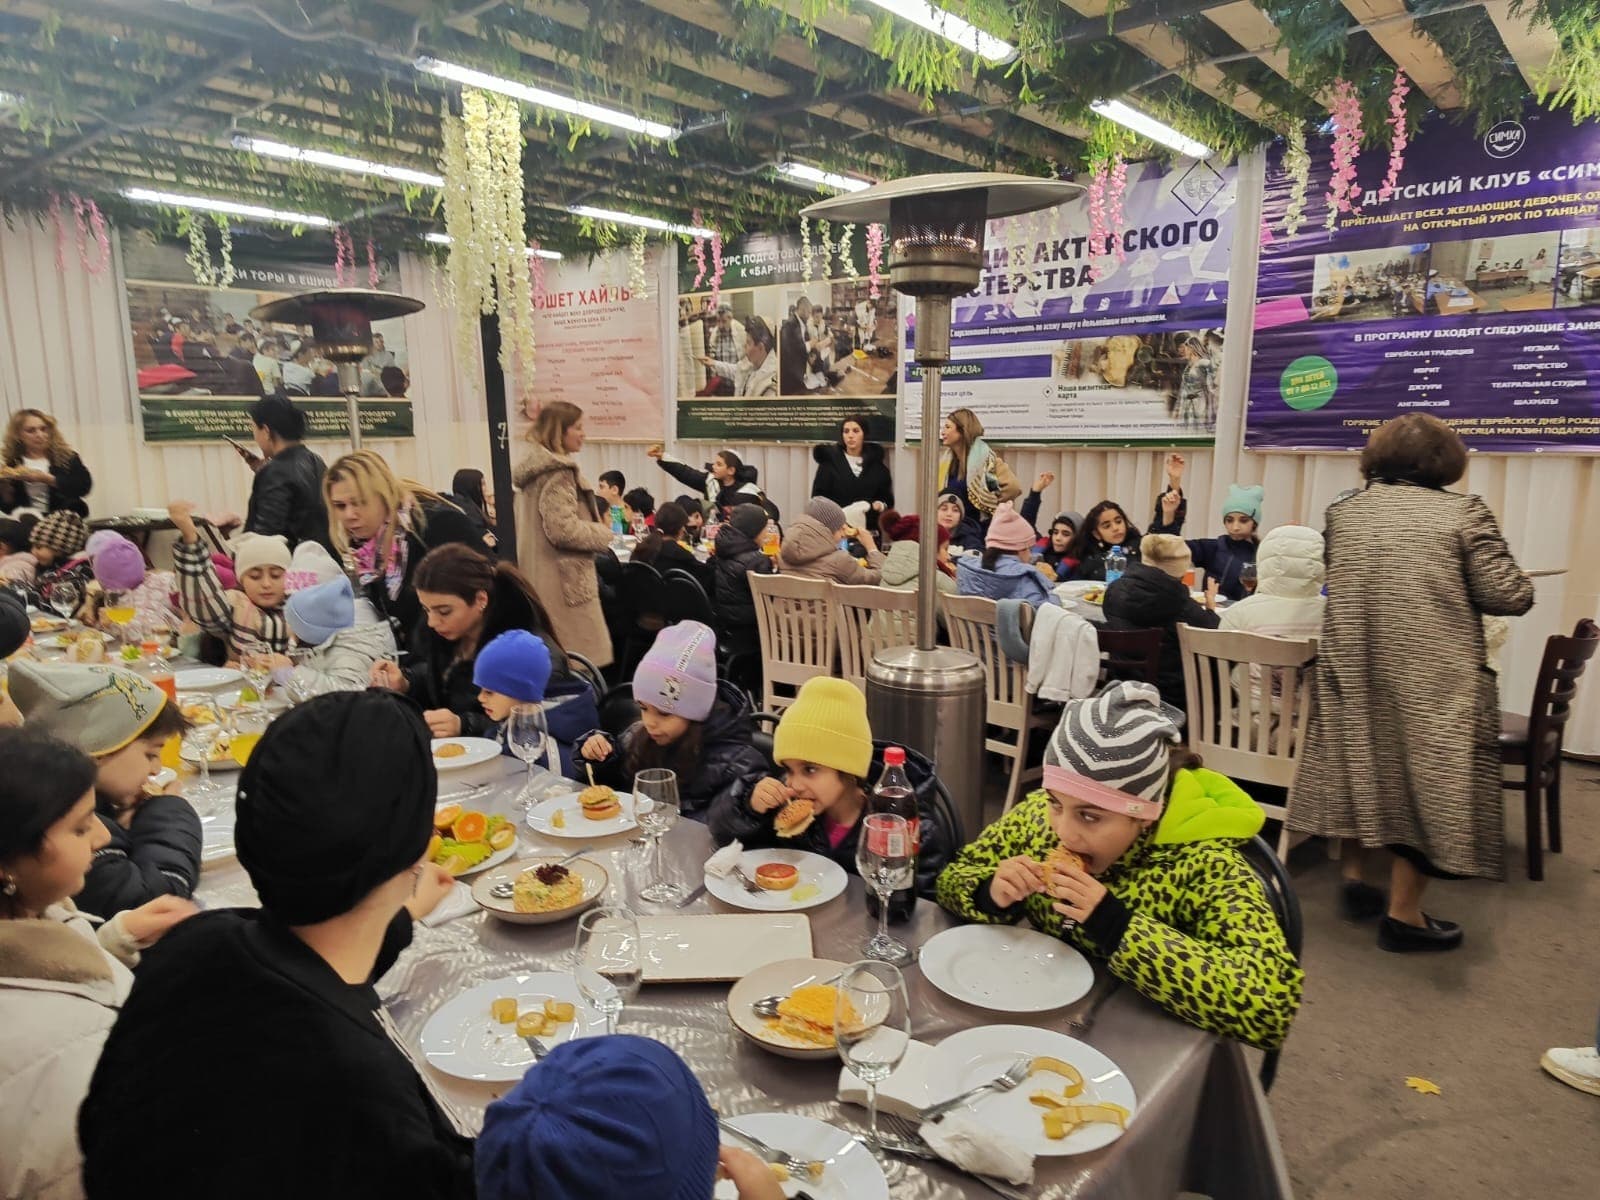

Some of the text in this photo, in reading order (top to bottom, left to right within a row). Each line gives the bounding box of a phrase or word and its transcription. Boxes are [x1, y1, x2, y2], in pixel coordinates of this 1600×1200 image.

[1489, 130, 1521, 143] СИМХА
[1362, 175, 1462, 206] ДТСКИЙ
[1469, 171, 1531, 191] КЛУБ
[1341, 212, 1413, 227] ПРИГЛАШАЕТ
[1415, 208, 1444, 219] ВСЕХ
[1446, 199, 1521, 216] ЖЕЛАЮЩИХ
[1523, 192, 1582, 208] ДЕВОЧЕК
[1403, 204, 1598, 232] НА ОТКРЫТЫЙ УРОК ПО ТАНЦАМ
[743, 246, 805, 265] ПОДГОТОВК
[250, 269, 285, 283] ТОРЫ
[288, 273, 297, 285] В
[741, 268, 747, 278] К
[1354, 334, 1362, 342] В
[1364, 330, 1432, 341] ПРОГРАММУ
[1434, 327, 1482, 338] ВХОДЯТ
[1484, 323, 1565, 335] СЛЕДУЮЩИЕ
[1523, 344, 1560, 352] МУЗЫКА
[1512, 362, 1568, 370] ТВОРЧЕСТВО
[1057, 384, 1076, 392] Наша
[1057, 392, 1077, 400] карта
[1513, 398, 1559, 406] ШАХМАТЫ
[1456, 427, 1495, 435] МЕСЯЦА
[1497, 427, 1542, 435] МАГАЗИН
